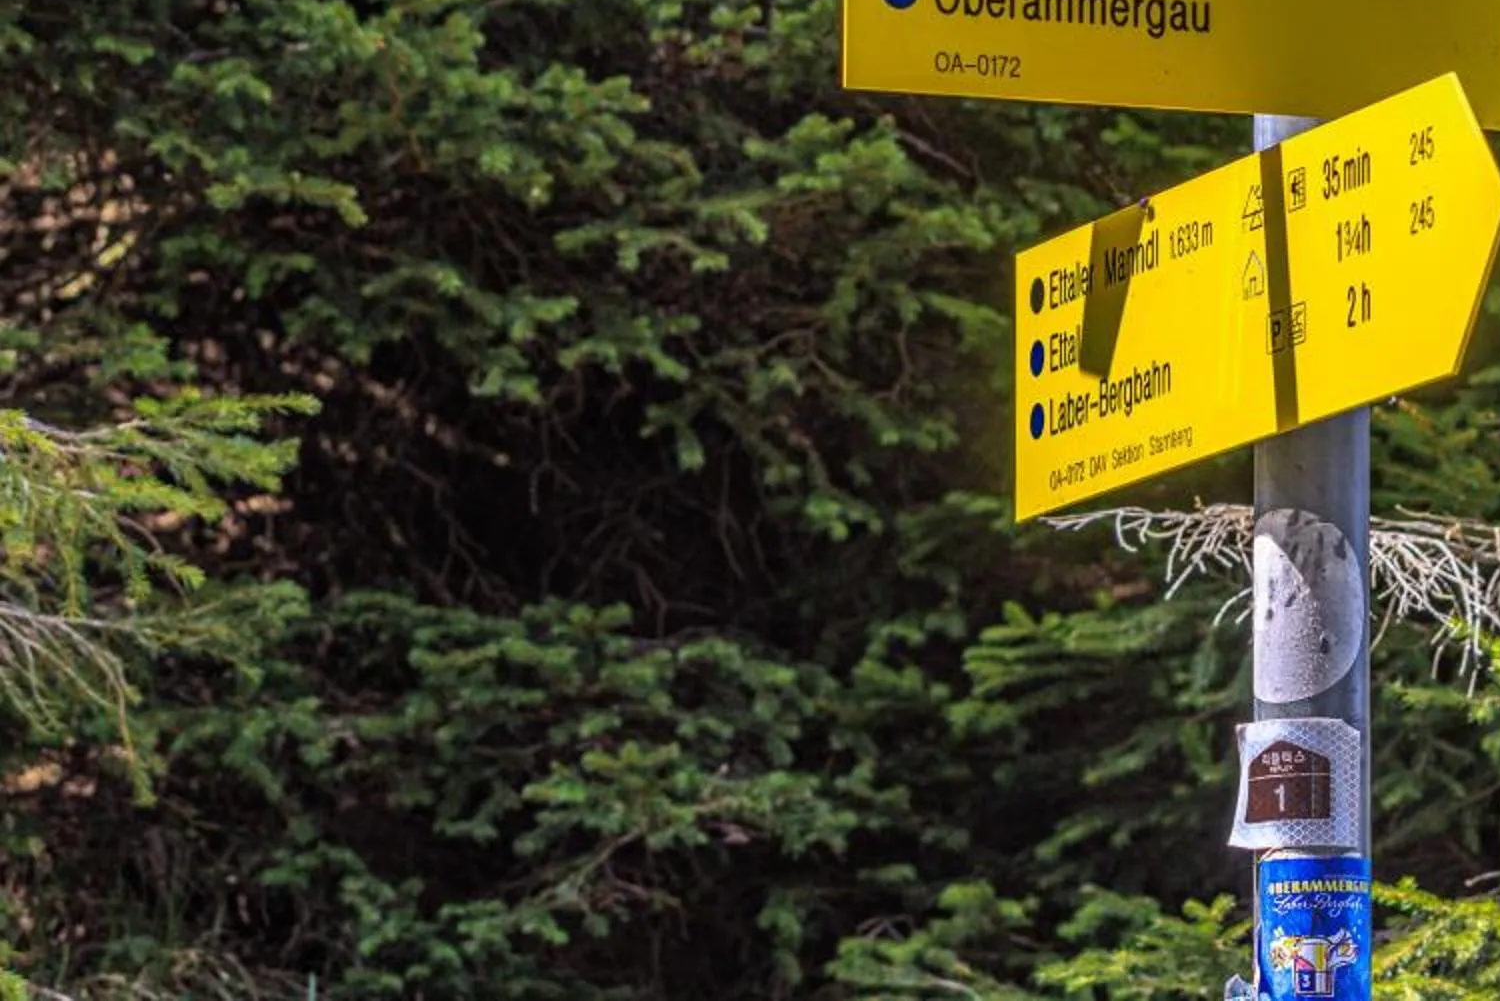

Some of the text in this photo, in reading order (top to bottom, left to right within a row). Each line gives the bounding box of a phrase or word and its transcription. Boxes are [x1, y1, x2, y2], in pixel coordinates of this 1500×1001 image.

[934, 51, 1021, 79] OA-0172
[1409, 126, 1435, 167] 245
[1322, 147, 1371, 201] 35 min
[1409, 195, 1435, 236] 245
[1049, 261, 1095, 310] Ettaler
[1104, 228, 1160, 289] Manndl
[1201, 221, 1213, 248] m
[1049, 359, 1172, 437] Laber-Bergbahn
